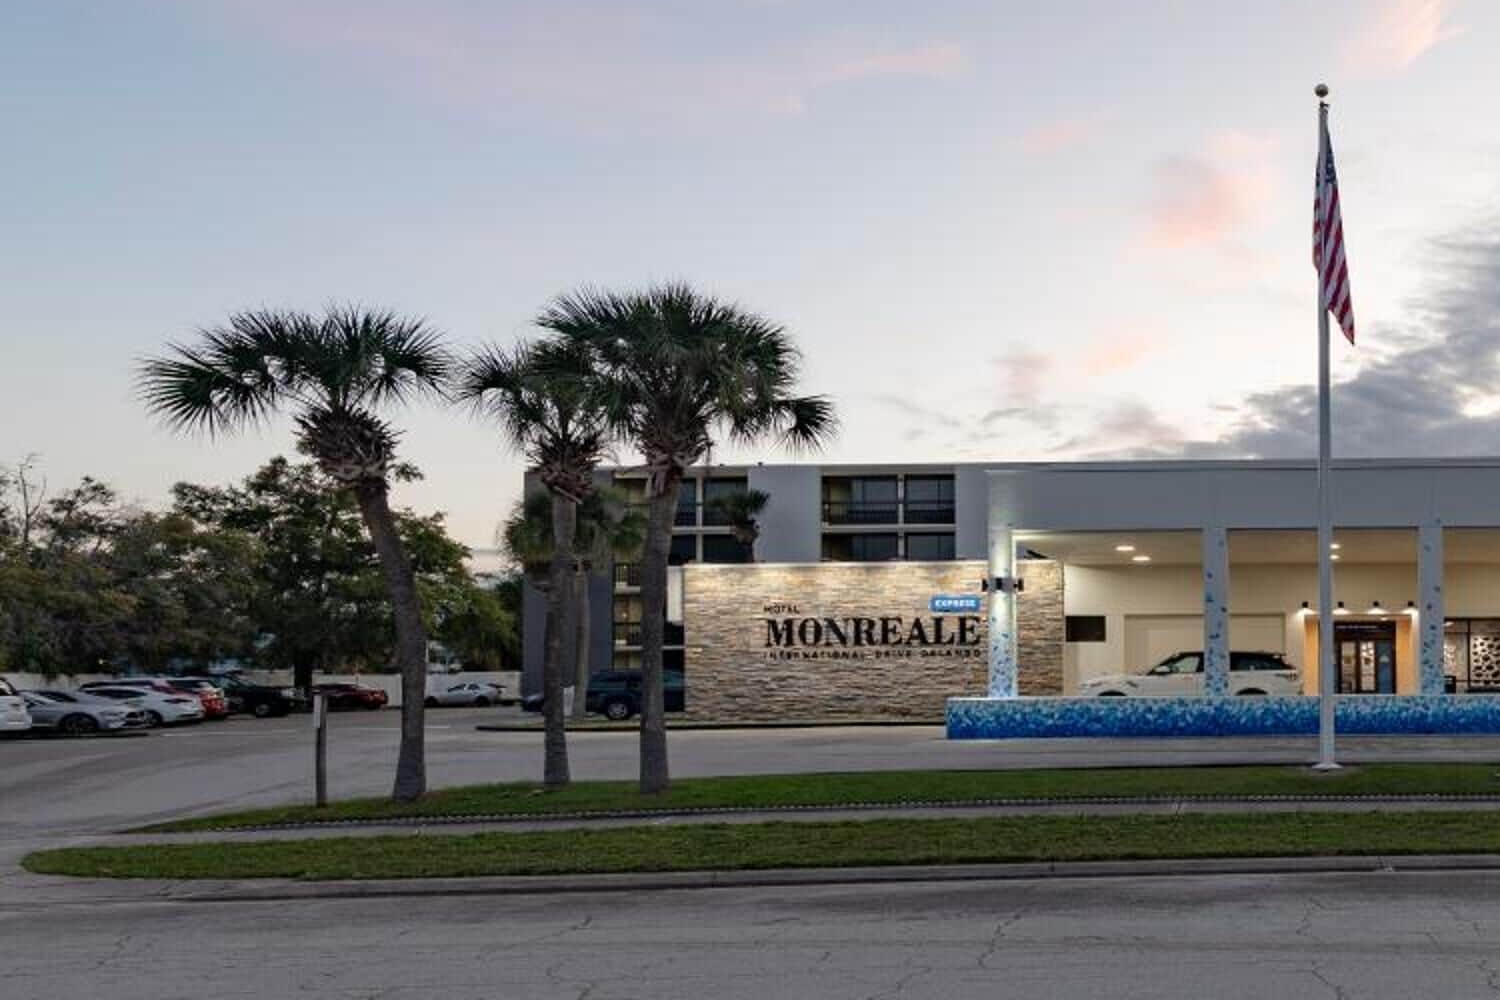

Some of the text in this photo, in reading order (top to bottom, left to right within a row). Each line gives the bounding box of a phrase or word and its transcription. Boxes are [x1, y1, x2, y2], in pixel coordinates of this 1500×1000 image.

[934, 598, 977, 608] EXPRESS
[764, 603, 800, 614] HOTEL
[765, 616, 981, 647] MONREALE
[763, 650, 864, 660] INTERNATIONAL
